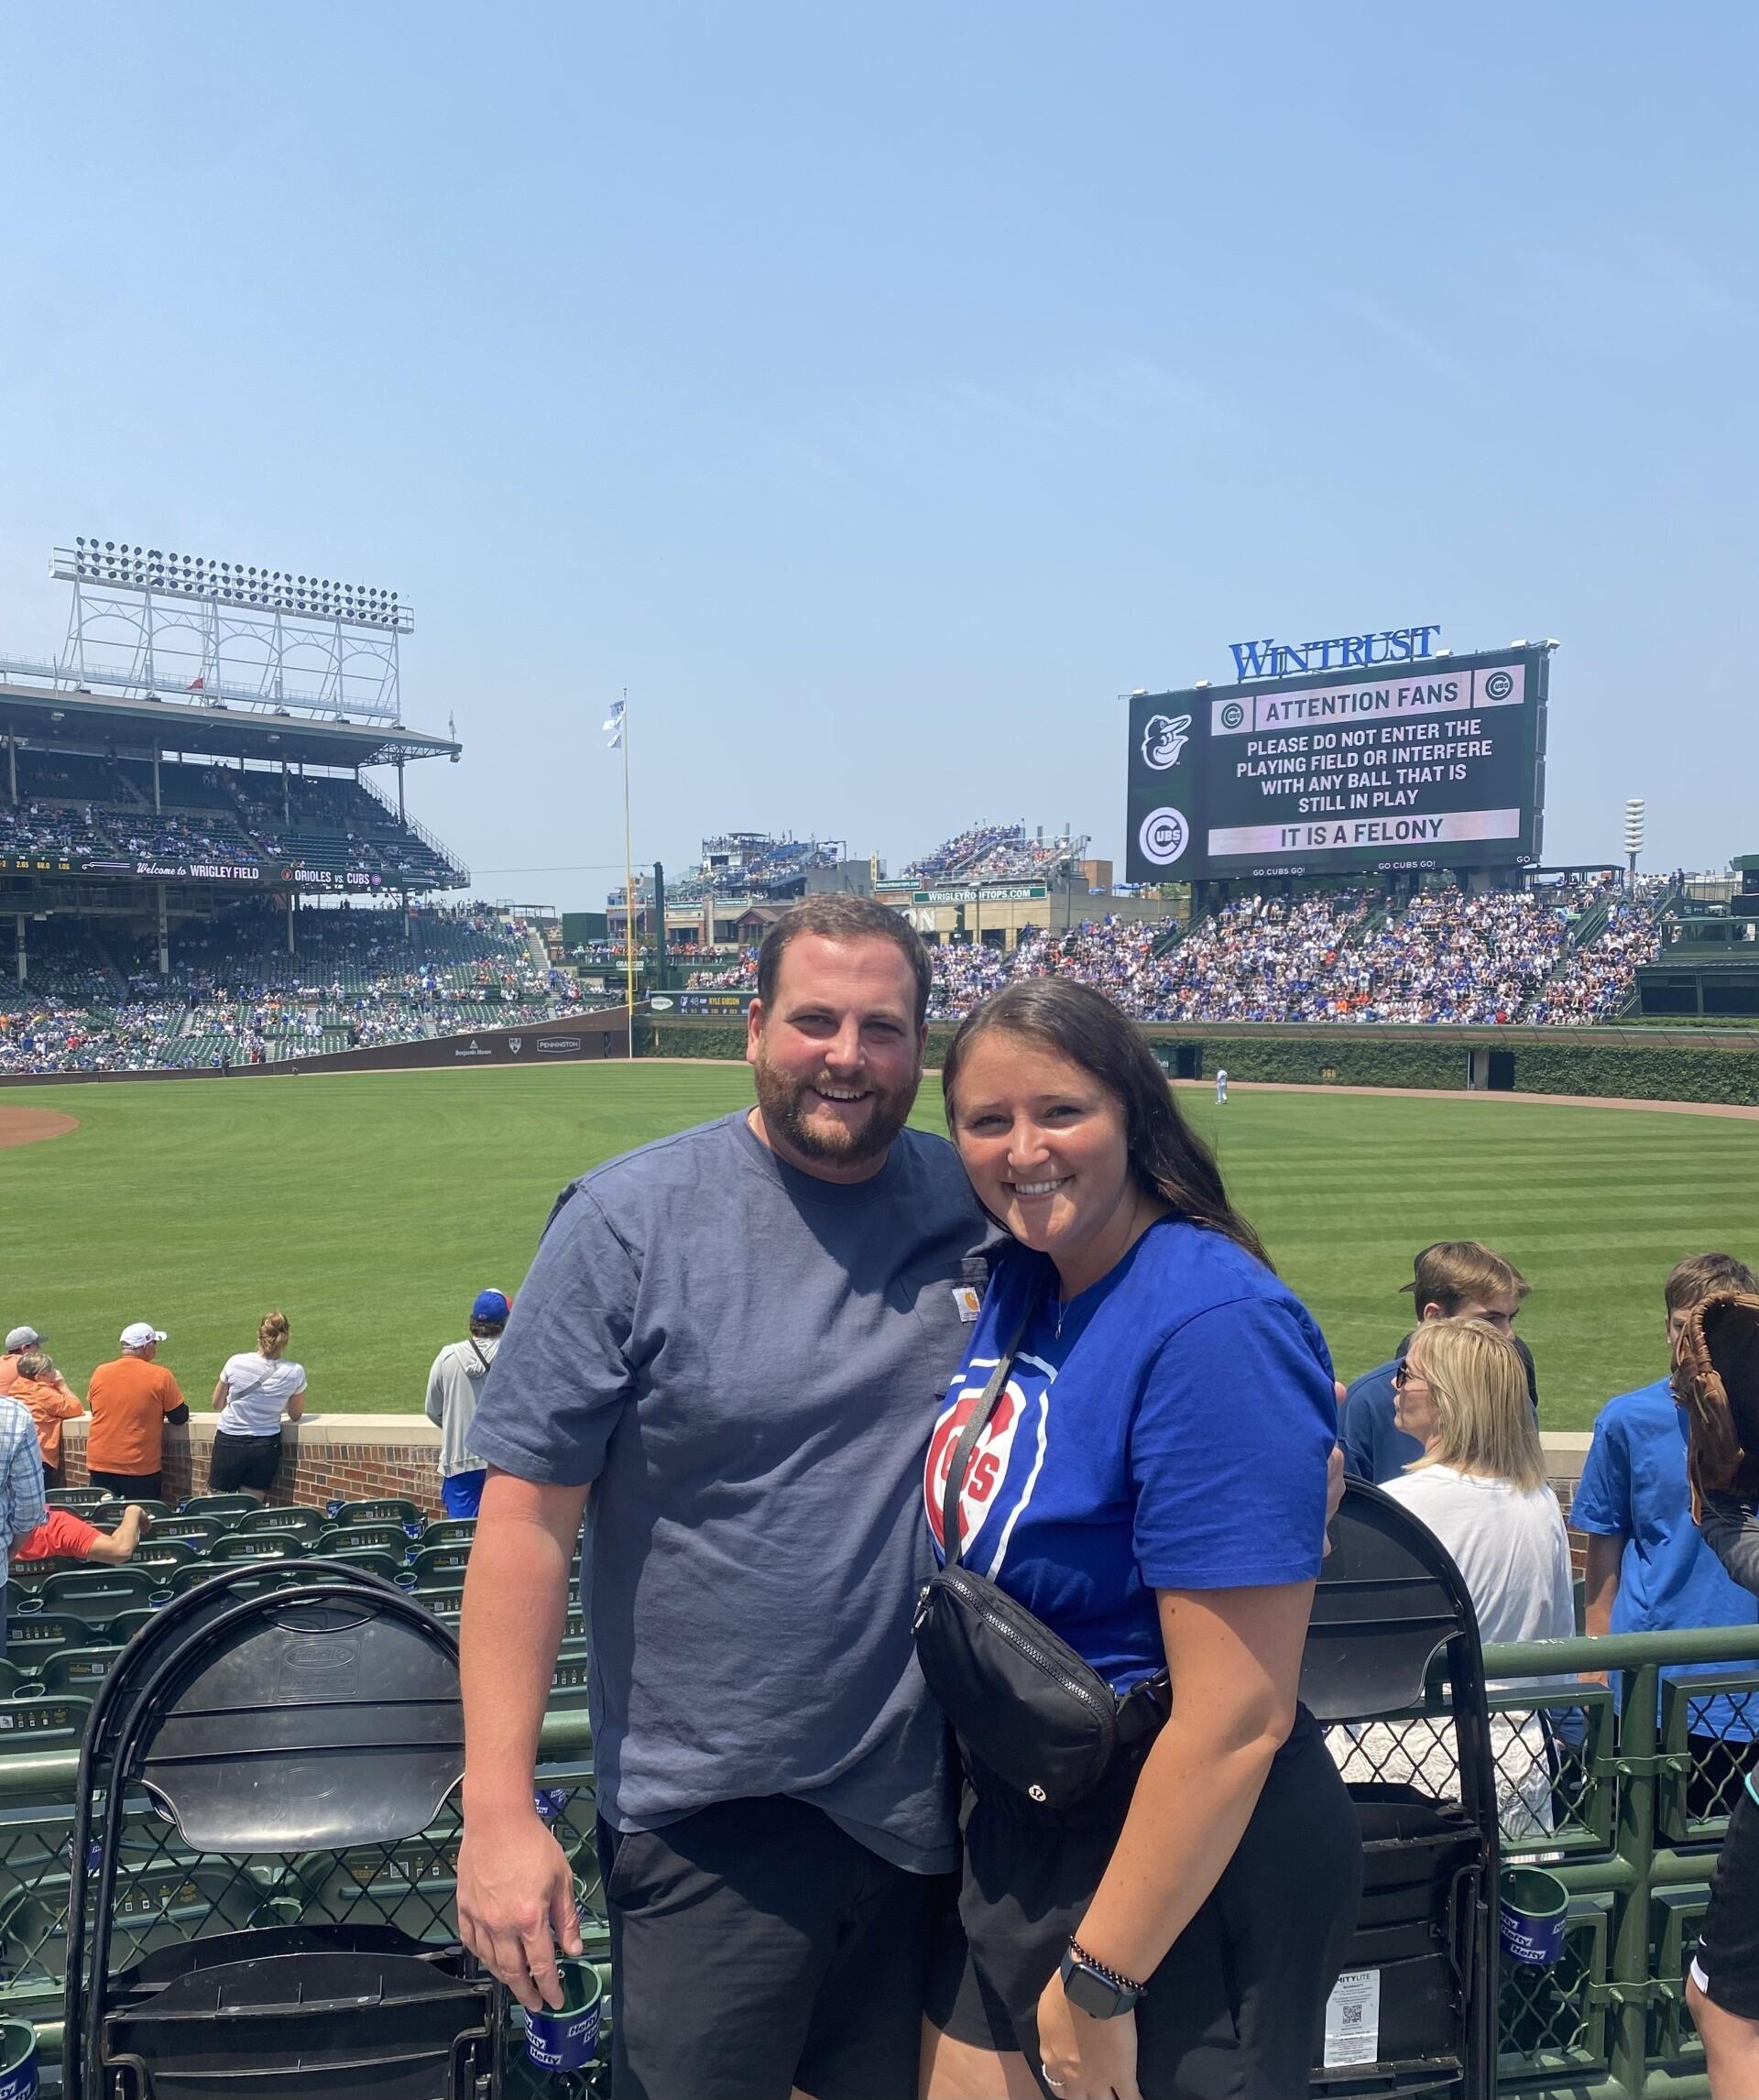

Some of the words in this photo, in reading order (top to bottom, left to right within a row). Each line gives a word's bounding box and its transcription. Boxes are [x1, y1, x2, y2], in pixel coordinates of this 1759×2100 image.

[1229, 625, 1440, 680] WINTRUST
[1266, 689, 1389, 722] ATTENTION
[1398, 682, 1459, 707] FANS
[1247, 737, 1308, 757] PLEASE
[1314, 734, 1335, 751] DO
[1341, 729, 1376, 748] NOT
[1382, 723, 1439, 744] ENTER
[1445, 718, 1481, 737] THE
[1237, 757, 1306, 778] PLAYING
[1311, 753, 1359, 771] FIELD
[1363, 749, 1387, 767] OR
[1393, 739, 1492, 764] INTERFERE
[1261, 778, 1305, 795] WITH
[1308, 774, 1344, 792] ANY
[1349, 771, 1392, 789] BALL
[1396, 765, 1445, 785] THAT
[1449, 763, 1467, 781] IS
[1298, 796, 1345, 814] STILL
[1350, 793, 1368, 810] IN
[1372, 789, 1419, 808] PLAY
[1281, 827, 1301, 848] IT
[1307, 826, 1327, 846] IS
[1333, 825, 1348, 844] A
[1354, 818, 1444, 843] FELONY
[137, 862, 176, 875] Welcome
[177, 866, 187, 876] to
[190, 864, 232, 878] WRIGLEY
[234, 867, 259, 880] FIELD
[294, 870, 332, 882] ORIOLES
[346, 872, 370, 885] CUBS
[1266, 868, 1289, 876] CUBS
[539, 1040, 578, 1049] PENNINGTON
[1512, 1944, 1544, 1959] Hefty
[570, 2016, 597, 2035] Hefty
[531, 2049, 560, 2064] Hefty
